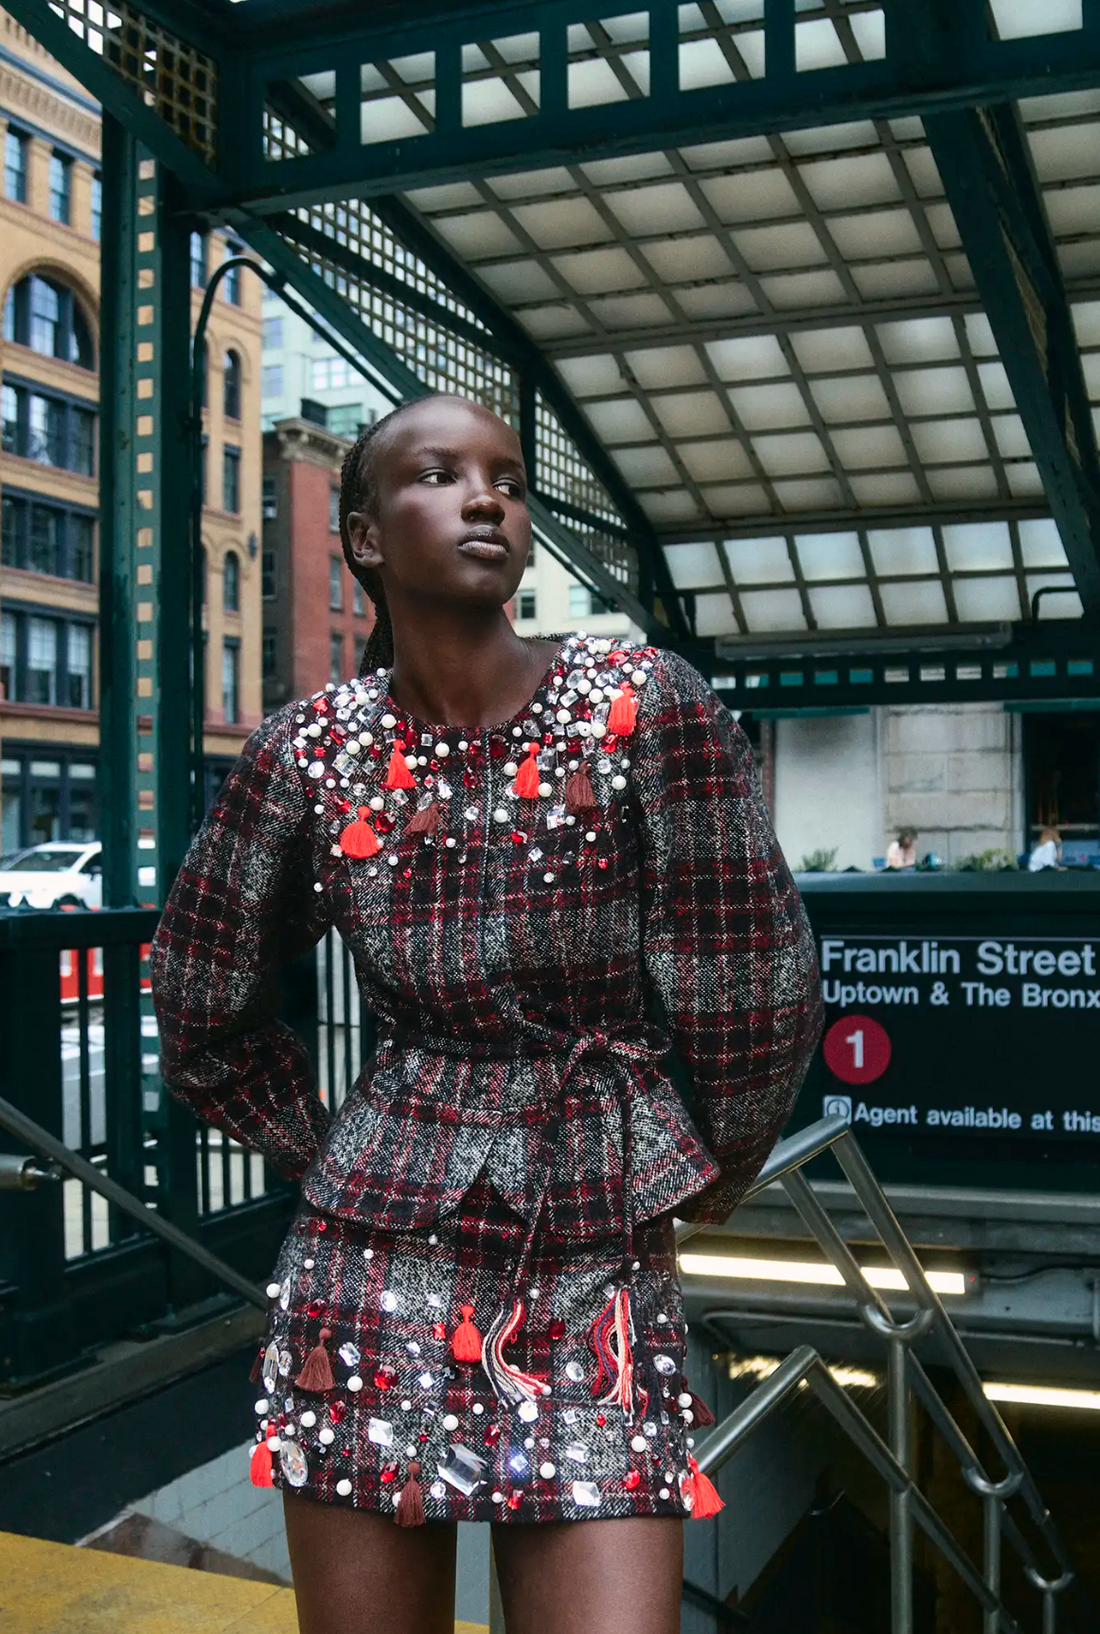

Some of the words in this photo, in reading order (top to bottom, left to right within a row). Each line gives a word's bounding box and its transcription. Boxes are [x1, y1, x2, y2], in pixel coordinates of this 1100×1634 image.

[821, 940, 960, 974] Franklin
[976, 941, 1096, 976] Street
[823, 979, 919, 1007] Uptown
[930, 981, 950, 1005] &
[961, 982, 1011, 1006] The
[1022, 983, 1100, 1008] Bronx
[846, 1030, 864, 1068] 1
[854, 1103, 918, 1127] Agent
[926, 1107, 1022, 1129] available
[1031, 1110, 1054, 1130] at
